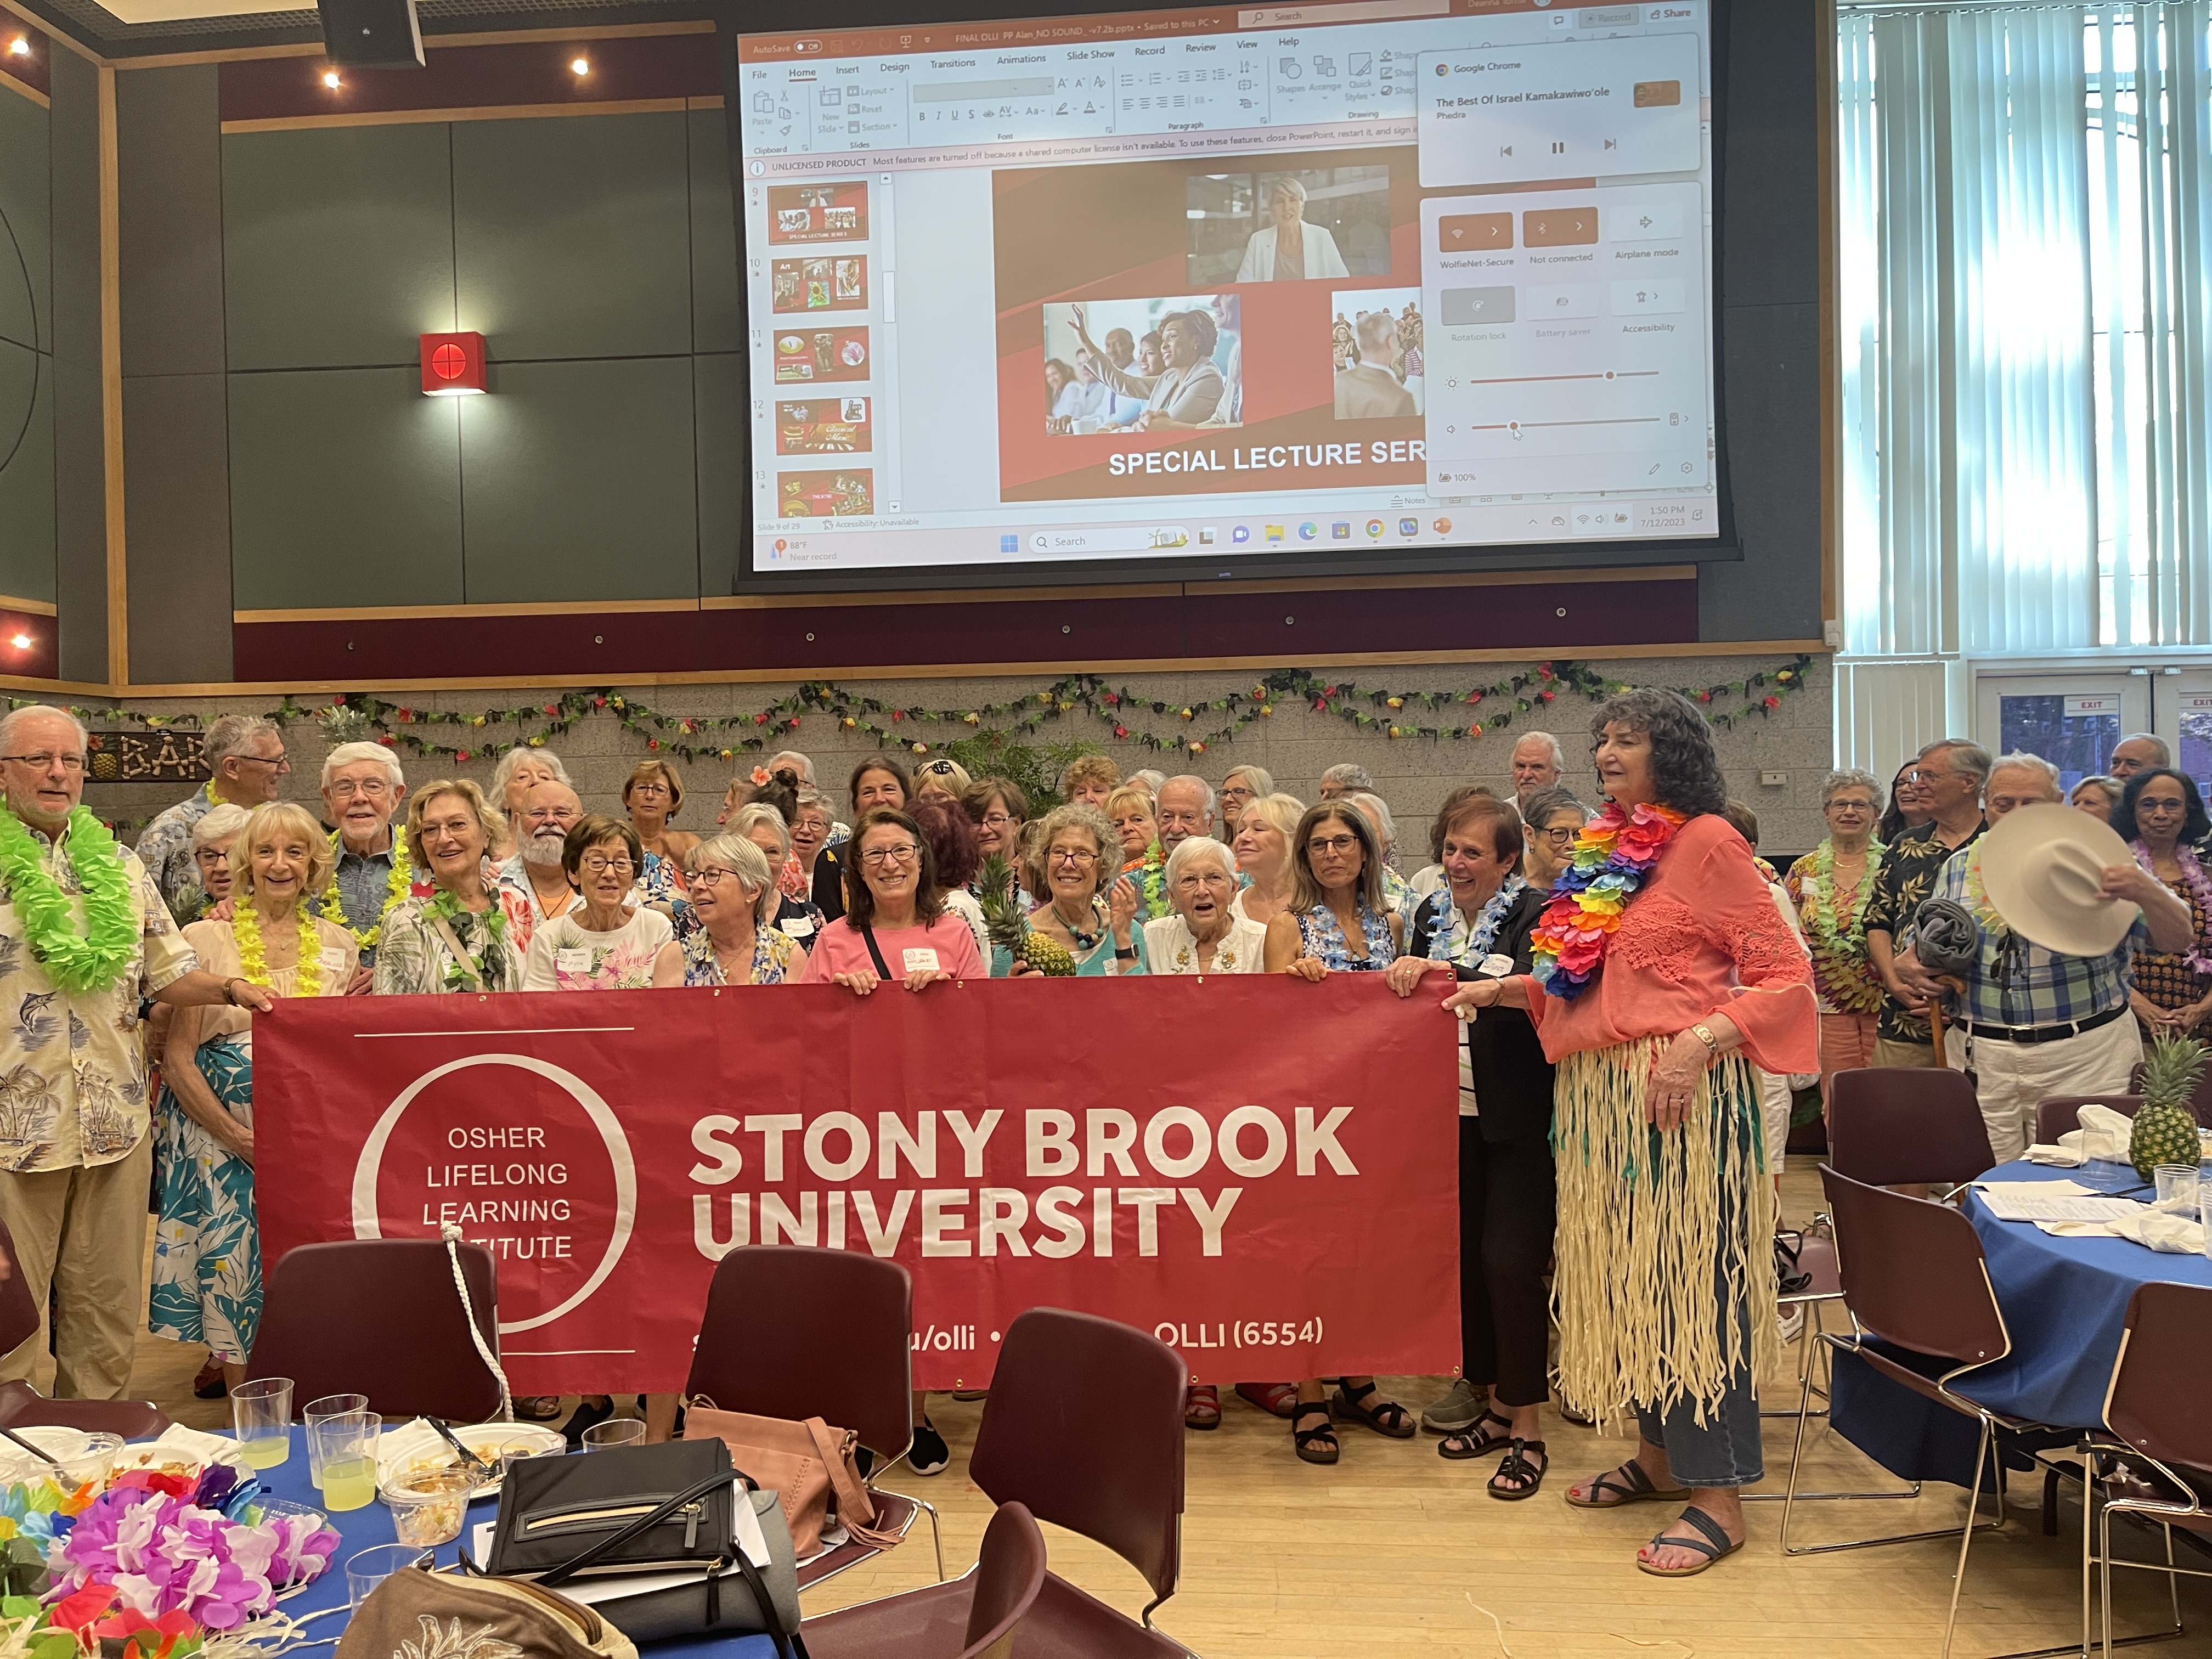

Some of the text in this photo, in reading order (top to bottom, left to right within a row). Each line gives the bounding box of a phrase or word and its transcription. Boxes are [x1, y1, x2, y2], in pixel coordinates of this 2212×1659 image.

[1275, 12, 1302, 21] Search
[1598, 13, 1631, 22] Record
[1664, 9, 1691, 18] Share
[956, 33, 980, 43] FINAL
[1144, 21, 1168, 31] Saved
[1182, 20, 1195, 28] this
[1198, 18, 1209, 27] PC
[753, 44, 791, 54] AutoSave
[789, 67, 816, 77] Home
[836, 65, 859, 75] Insert
[881, 62, 910, 74] Design
[931, 59, 975, 69] Transitions
[997, 54, 1046, 65] Animations
[1067, 50, 1088, 60] Slide
[1091, 49, 1115, 59] Show
[1135, 46, 1165, 55] Record
[1186, 42, 1216, 53] Review
[1237, 40, 1258, 49] View
[1279, 37, 1299, 47] Help
[1454, 61, 1521, 74] Google Chrome
[1309, 82, 1341, 92] Arrange
[1349, 80, 1372, 88] Quick
[861, 87, 887, 97] Layout
[1277, 85, 1306, 94] Shapes
[1345, 93, 1368, 103] Styles
[1436, 98, 1454, 108] The
[1458, 97, 1478, 106] Best
[1481, 95, 1493, 105] Of
[1497, 93, 1522, 103] Israel
[861, 105, 882, 114] Reset
[1348, 111, 1379, 119] Drawing
[1437, 111, 1466, 120] Phedra
[862, 123, 890, 132] Section
[1168, 121, 1204, 131] Paragraph
[754, 146, 787, 156] Clipboard
[772, 161, 823, 171] UNLICENSED
[826, 159, 866, 168] PRODUCT
[873, 157, 893, 165] Most
[896, 155, 926, 164] features
[943, 152, 968, 161] turned
[971, 151, 983, 159] off
[985, 150, 1015, 159] because
[1025, 148, 1051, 156] shared
[1054, 145, 1092, 155] computer
[1094, 144, 1120, 153] license
[1122, 142, 1138, 151] isn't
[1141, 140, 1177, 150] available.
[1207, 137, 1228, 145] these
[1230, 136, 1263, 144] features,
[1266, 133, 1286, 142] close
[1338, 129, 1363, 138] restart
[1375, 127, 1391, 136] and
[1394, 126, 1410, 136] sign
[752, 188, 758, 196] 9
[749, 258, 760, 267] 10
[1440, 249, 1679, 269] WolfieNet-Secure Not connected Airplane mode
[751, 330, 761, 338] 11
[1452, 334, 1487, 342] Rotation
[1490, 331, 1506, 340] lock
[1536, 329, 1566, 338] Battery
[1622, 323, 1675, 333] Accessibility
[753, 400, 764, 409] 12
[1109, 439, 1426, 476] SPECIAL LECTURE SER
[755, 471, 766, 480] 13
[1454, 473, 1476, 482] 100%
[1651, 505, 1685, 515] 1:50 PM
[758, 523, 775, 532] Slide
[791, 522, 800, 531] 29
[836, 520, 878, 530] Accessibility:
[880, 518, 920, 527] Unavailable
[1641, 518, 1685, 528] 7/12/2023
[1056, 536, 1086, 546] Search
[811, 552, 837, 561] record
[2081, 701, 2103, 709] EXIT
[448, 1127, 546, 1149] OSHER
[688, 1105, 1359, 1185] STONY BROOK
[427, 1163, 568, 1187] LIFELONG
[423, 1199, 571, 1225] LEARNING
[692, 1186, 1244, 1262] UNIVERSITY
[461, 1236, 572, 1260] ITUTE
[1234, 1317, 1323, 1348] (6554)
